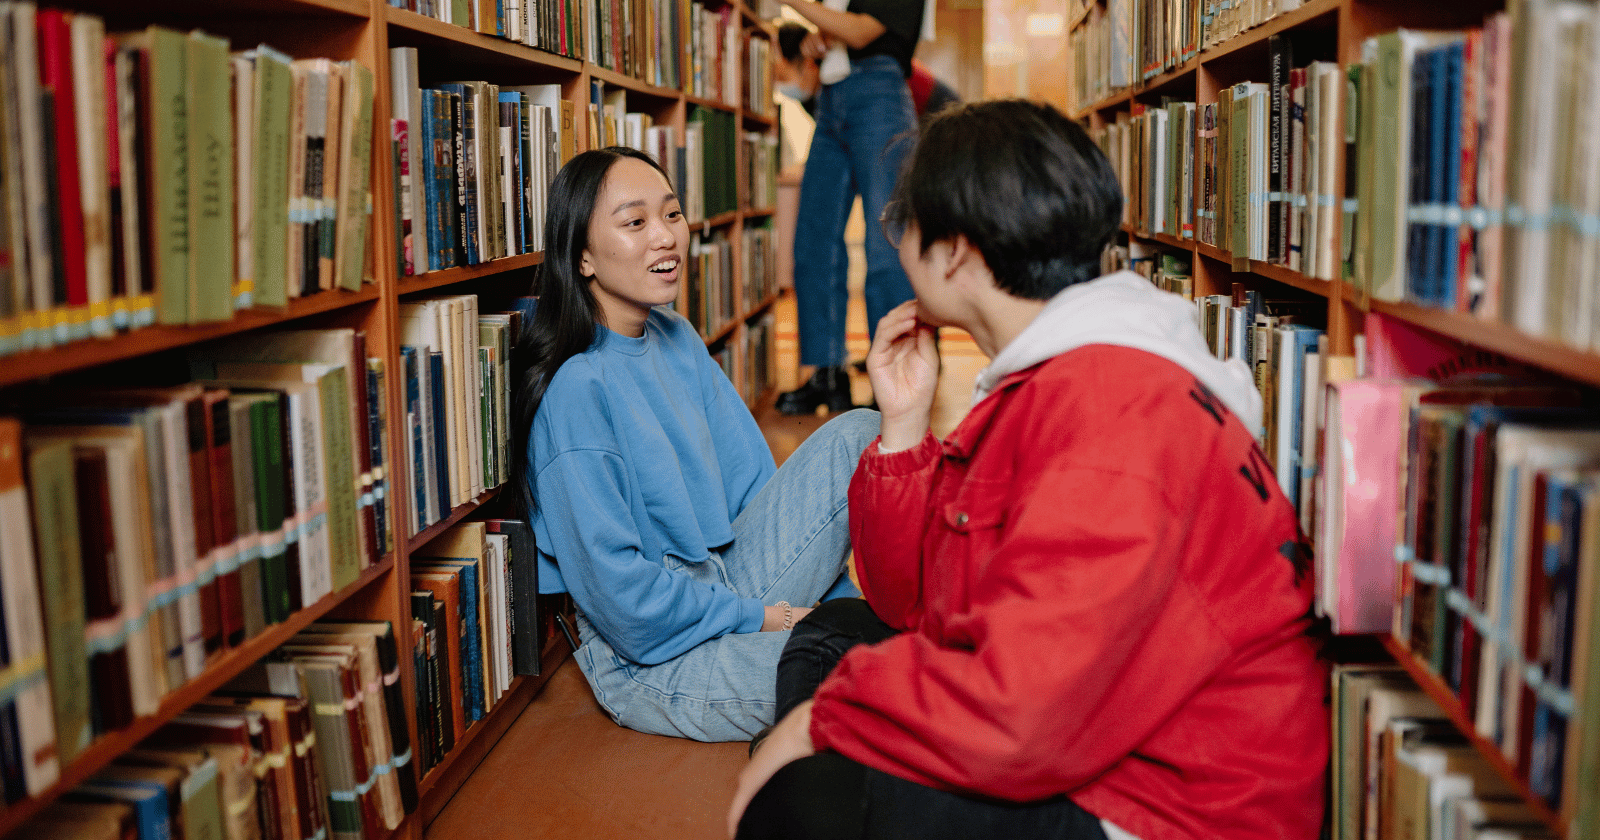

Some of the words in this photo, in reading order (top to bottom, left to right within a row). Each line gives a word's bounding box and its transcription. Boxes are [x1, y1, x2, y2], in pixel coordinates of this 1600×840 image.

[1273, 53, 1281, 111] ЛИТЕРАТУРА
[203, 132, 221, 218] Шоу
[456, 131, 465, 207] АСТАФЬЕВ
[1271, 115, 1280, 174] КИТАЙСКАЯ
